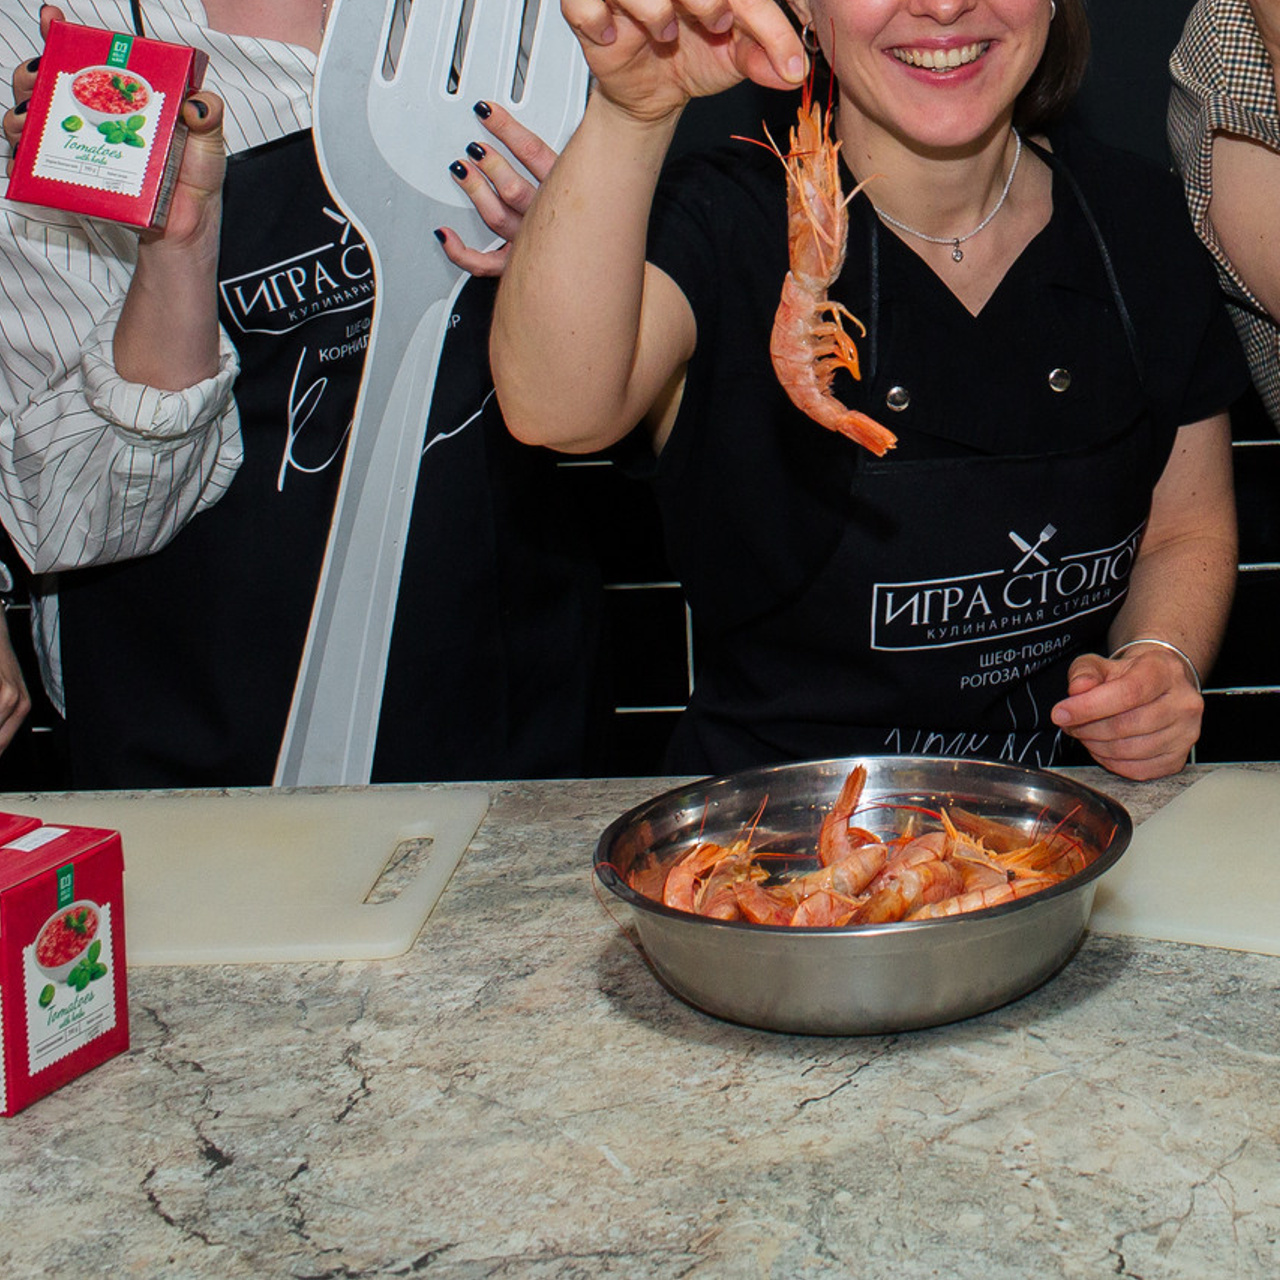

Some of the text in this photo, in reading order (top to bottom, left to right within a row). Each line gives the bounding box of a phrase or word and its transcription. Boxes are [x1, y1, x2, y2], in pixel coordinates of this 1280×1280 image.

[63, 134, 123, 159] Tomatoes
[233, 260, 340, 316] ИГРА
[288, 279, 375, 322] КУЛИНАРН
[883, 533, 1139, 626] ИГРА СТОЛО
[926, 588, 1112, 639] КУЛИНАРНАЯ СТУДИЯ
[979, 634, 1072, 668] ШЕФ-ПОВАР
[960, 666, 1021, 690] РОГОЗА
